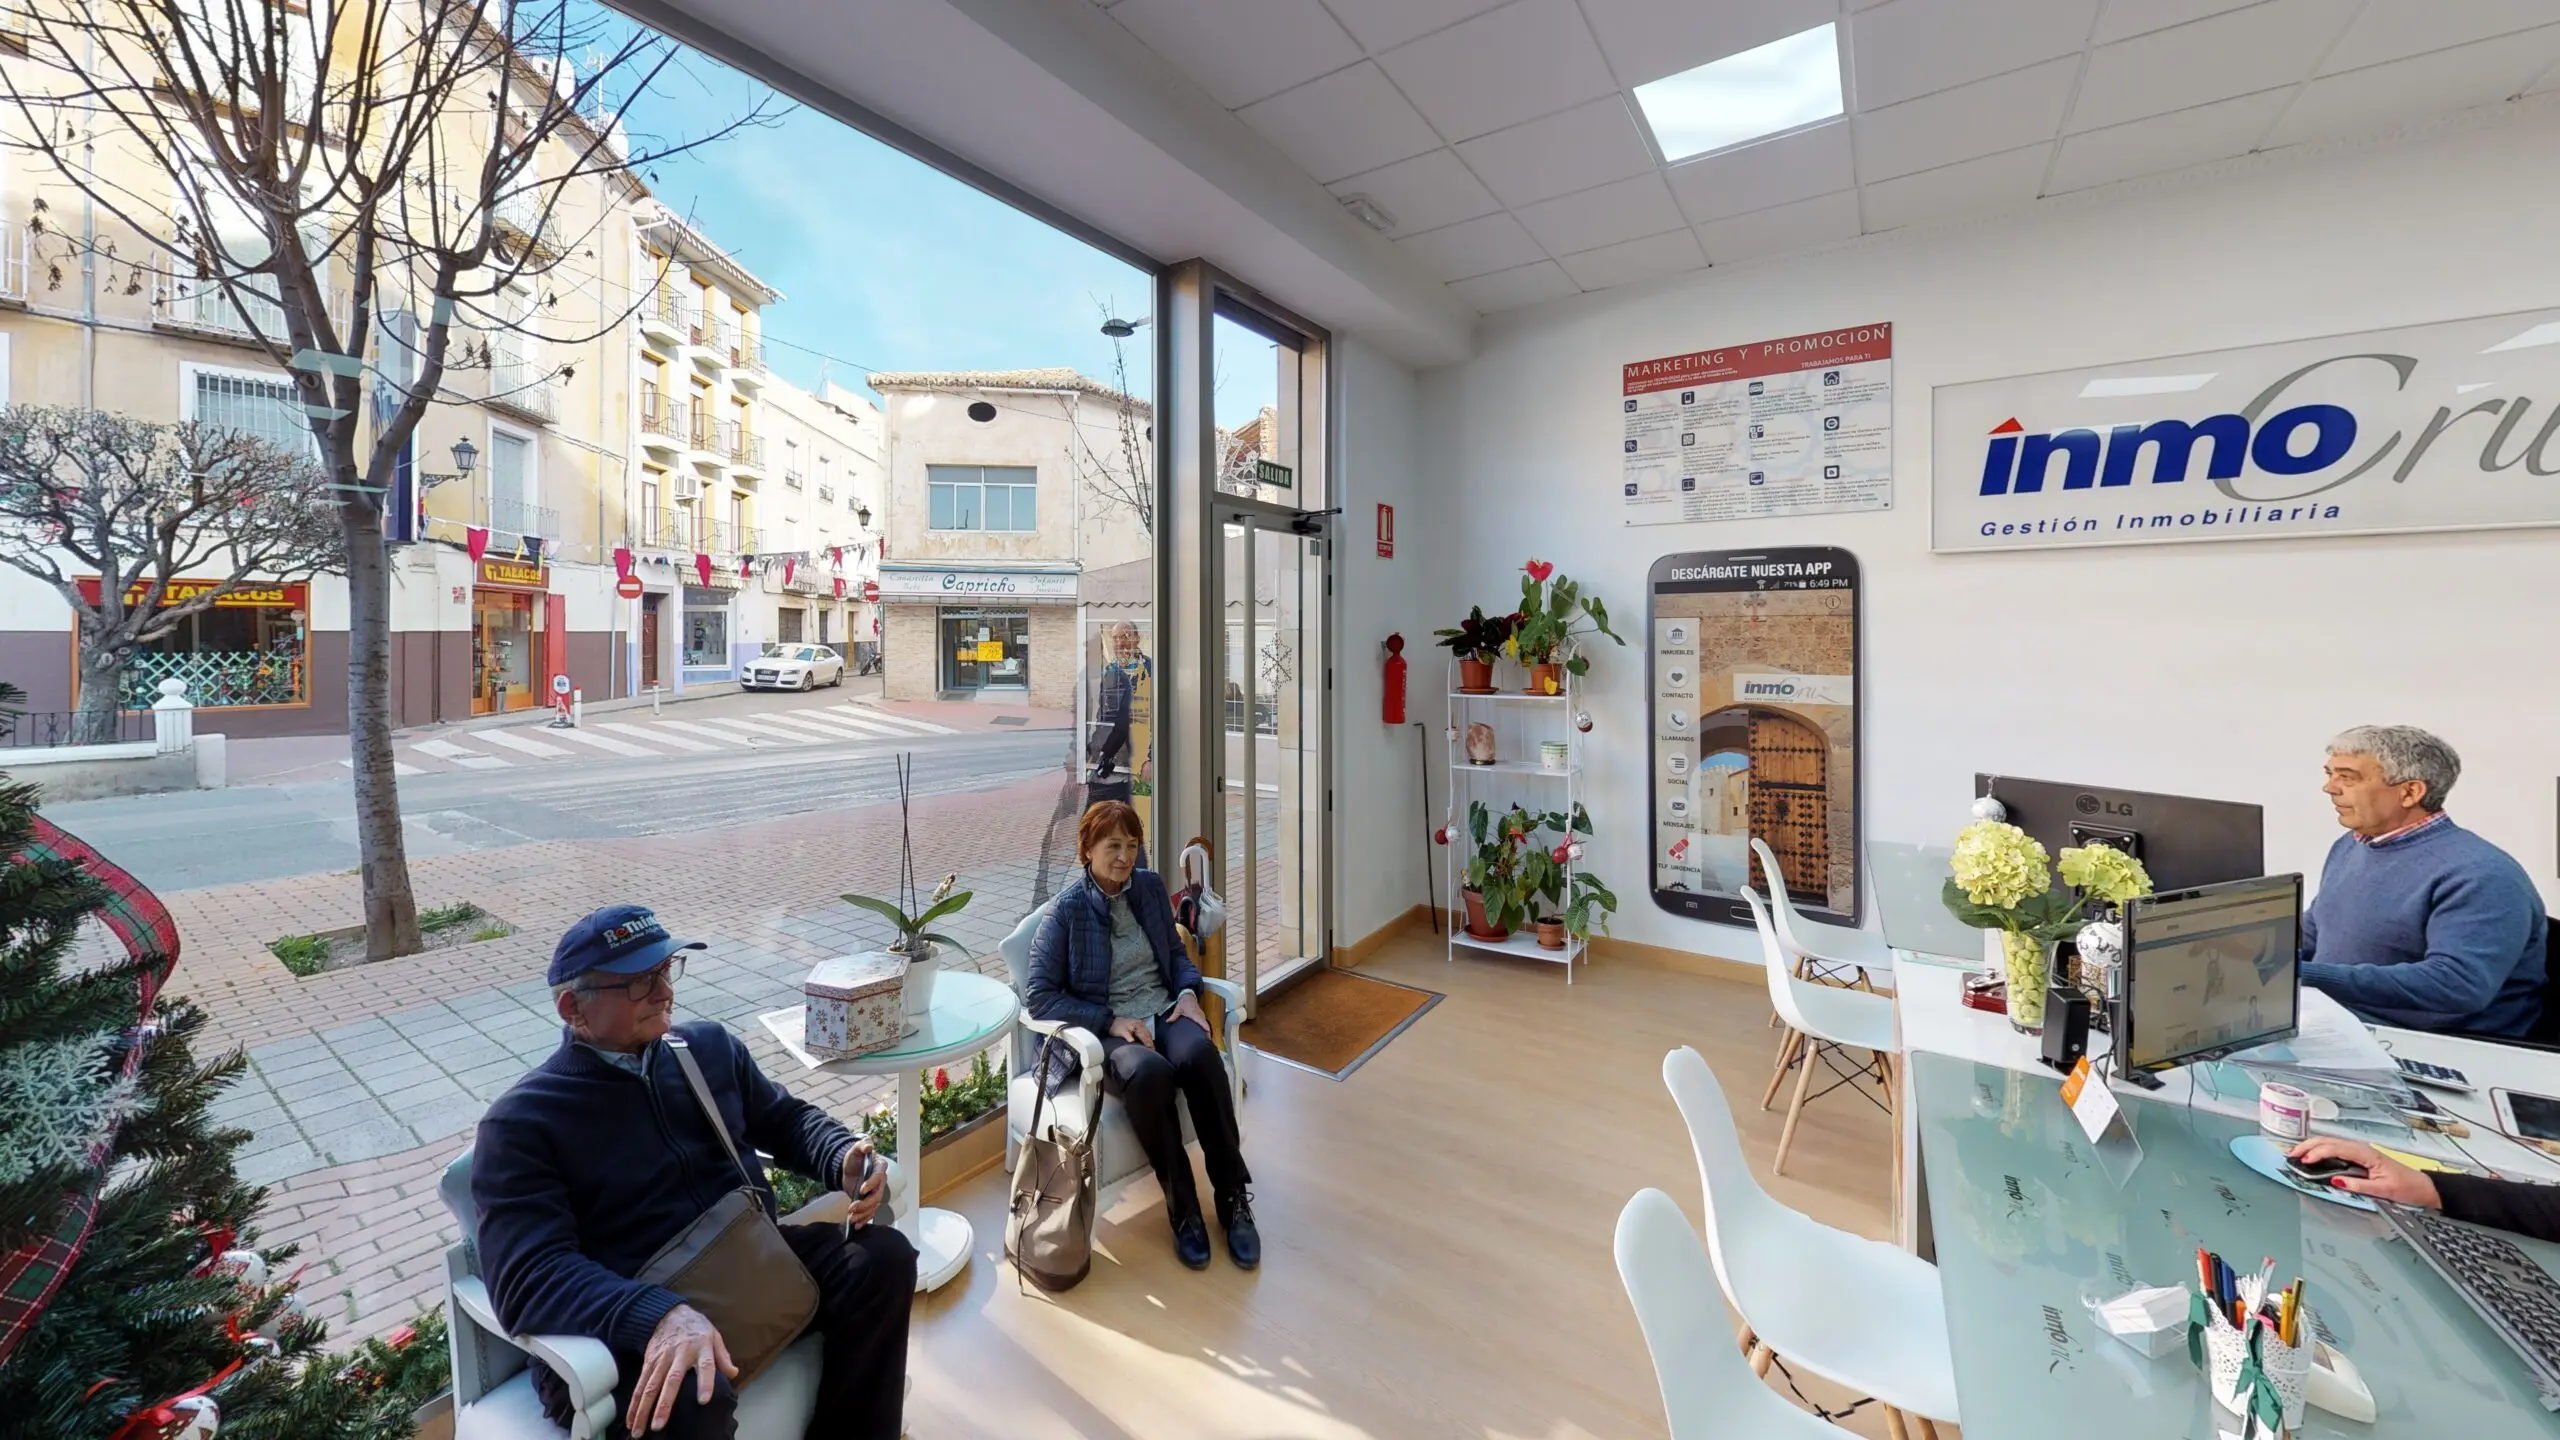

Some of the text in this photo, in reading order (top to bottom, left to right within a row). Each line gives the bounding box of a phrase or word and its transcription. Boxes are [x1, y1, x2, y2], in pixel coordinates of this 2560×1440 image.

[1627, 327, 1886, 378] MARKETING Y PROMOCION
[1801, 356, 1844, 368] TRABAJAMOS
[1845, 354, 1864, 363] PARA
[1258, 462, 1290, 485] SALIDA
[1980, 503, 2340, 537] Gestión Inmobiliaria
[1671, 561, 1832, 580] DESCÁRGATE NUESTA APP
[942, 573, 1016, 595] Capricho
[1809, 579, 1829, 588] 6:49
[1831, 578, 1848, 588] PM
[1661, 735, 1695, 743] LLAMANOS
[1667, 778, 1688, 786] SOCIAL
[2105, 800, 2133, 817] LG
[1663, 821, 1695, 829] MENSAJES
[1670, 864, 1701, 873] URGENCIA
[603, 915, 658, 944] ReThin
